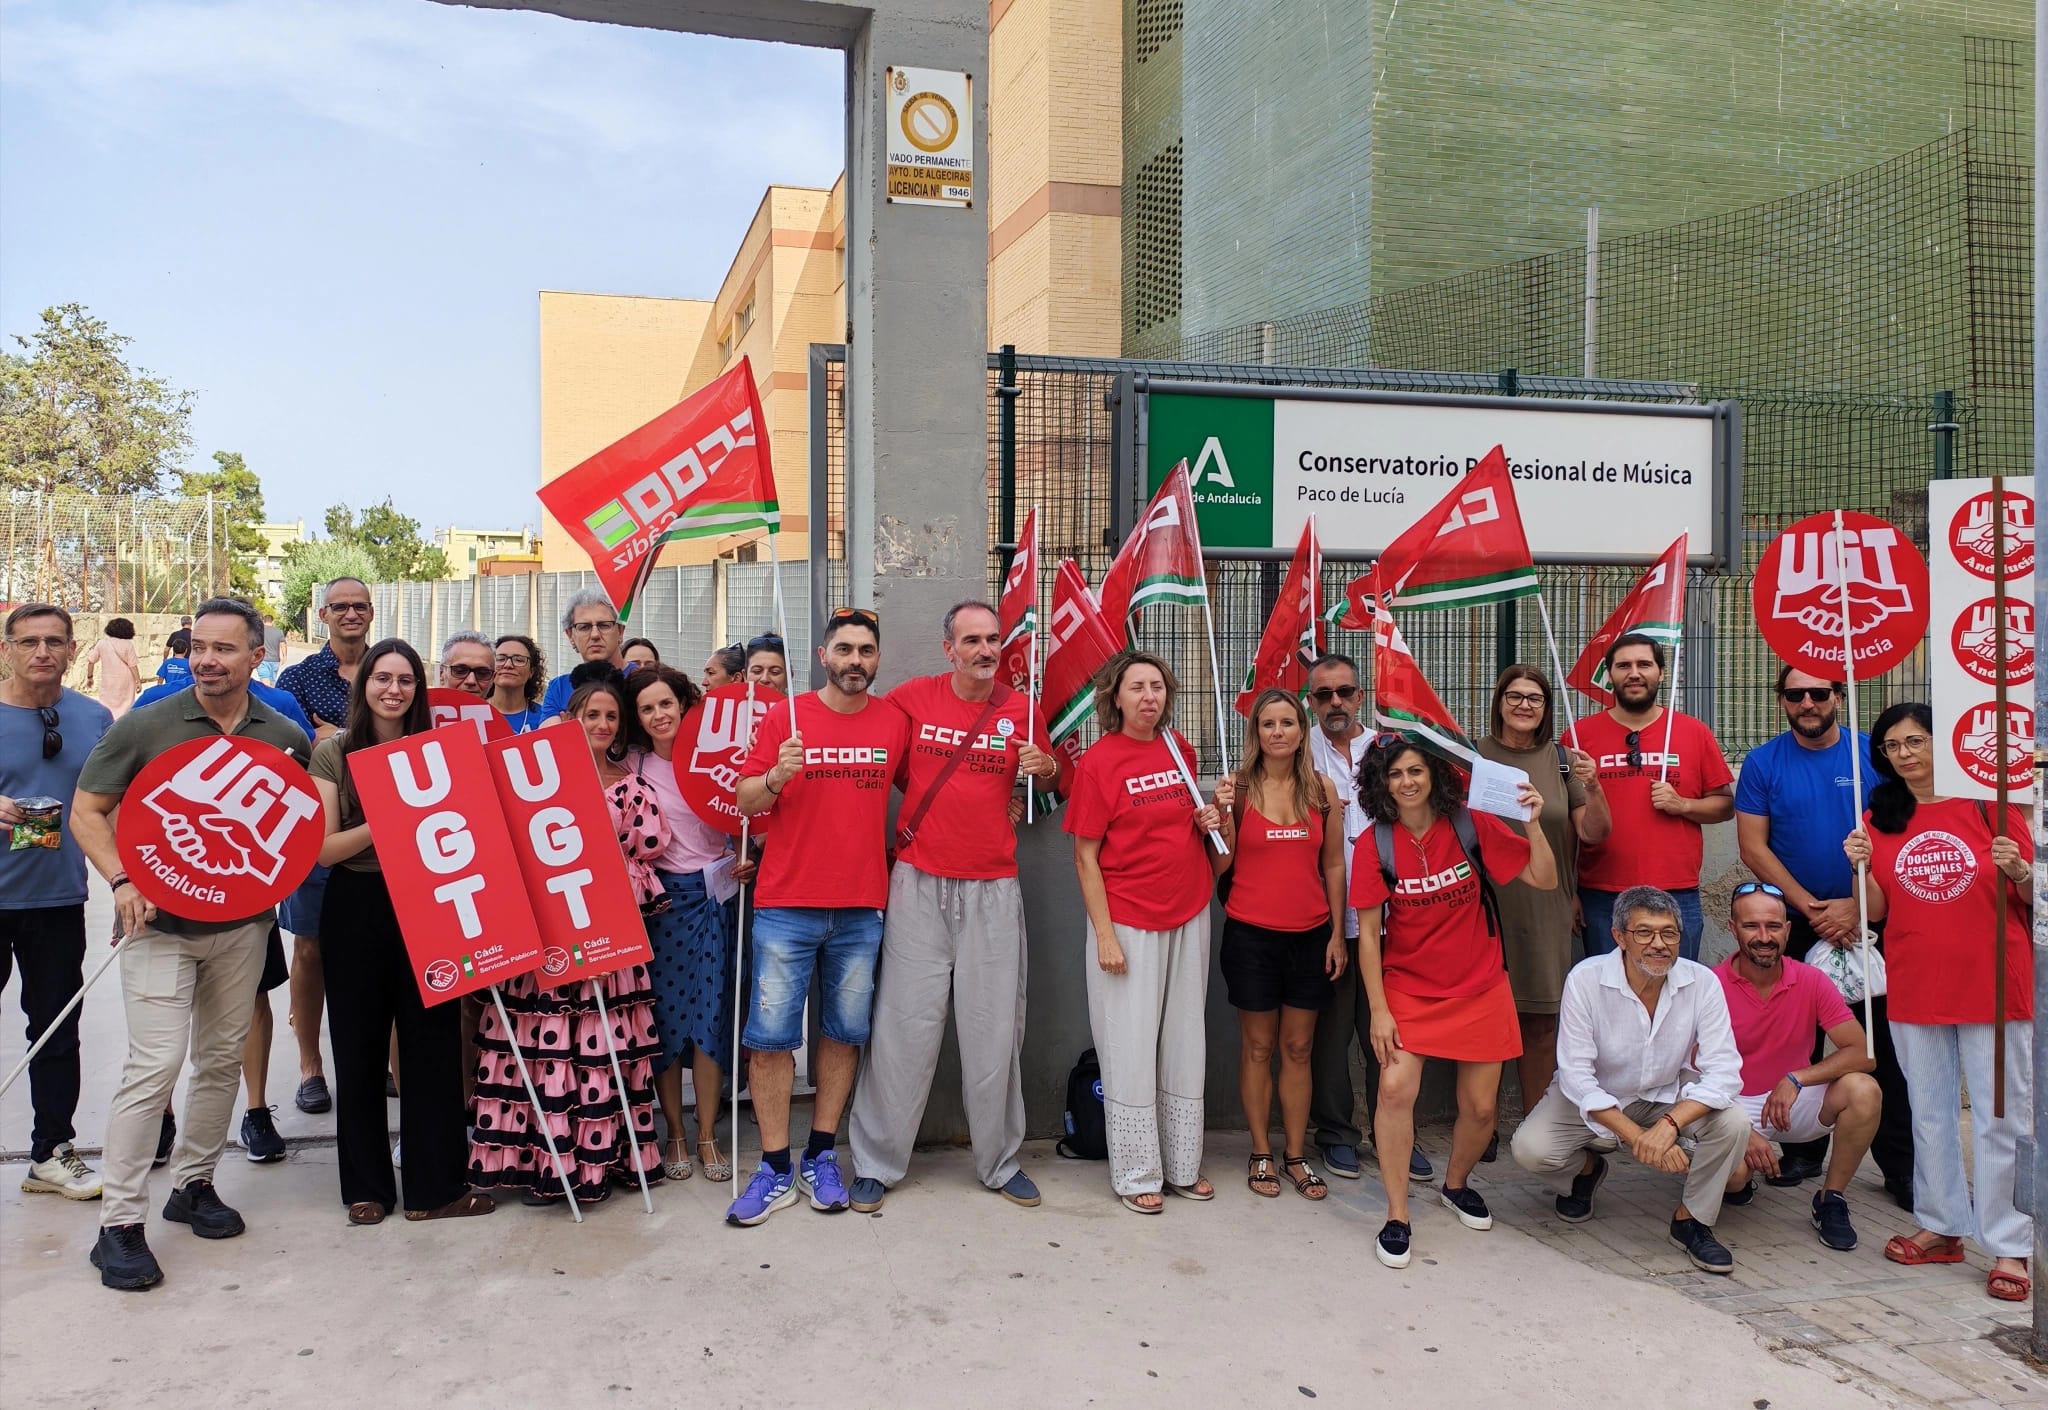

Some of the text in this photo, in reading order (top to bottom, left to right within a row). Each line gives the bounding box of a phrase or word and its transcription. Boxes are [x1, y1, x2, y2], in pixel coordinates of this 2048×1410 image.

[889, 152, 972, 168] VADO PERMANENTE
[888, 166, 970, 182] AYTO. DE ALGECIRAS
[889, 181, 929, 196] LICENCIA
[948, 187, 970, 197] 1946
[1299, 450, 1692, 485] Conservatorio Pfesional de Música
[1193, 491, 1262, 505] de Andalucía
[1298, 485, 1404, 504] Paco de Lucía
[1777, 528, 1898, 594] UGT
[1798, 638, 1894, 663] Andaucía
[697, 696, 777, 753] UG
[919, 723, 989, 750] CCOO
[805, 747, 872, 765] CCOO
[916, 743, 1006, 765] enseanza
[805, 767, 886, 780] enseñanza
[969, 762, 1006, 775] Cádiz
[1125, 769, 1181, 795] CCOO
[172, 737, 320, 852] UGT
[387, 740, 486, 940] UGT
[501, 738, 593, 930] UGT
[1267, 829, 1301, 840] CCOO
[1907, 851, 1961, 865] DOCENTES
[136, 844, 226, 904] Andalucía
[1907, 862, 1963, 877] ESENCIALES
[1394, 880, 1477, 908] enseñanza
[1898, 871, 1976, 901] DIGNIDAD LABORAL
[474, 944, 504, 960] Cádiz
[583, 936, 611, 949] Cádiz
[479, 949, 538, 974] Servicios Públicos
[588, 951, 617, 963] Servicios
